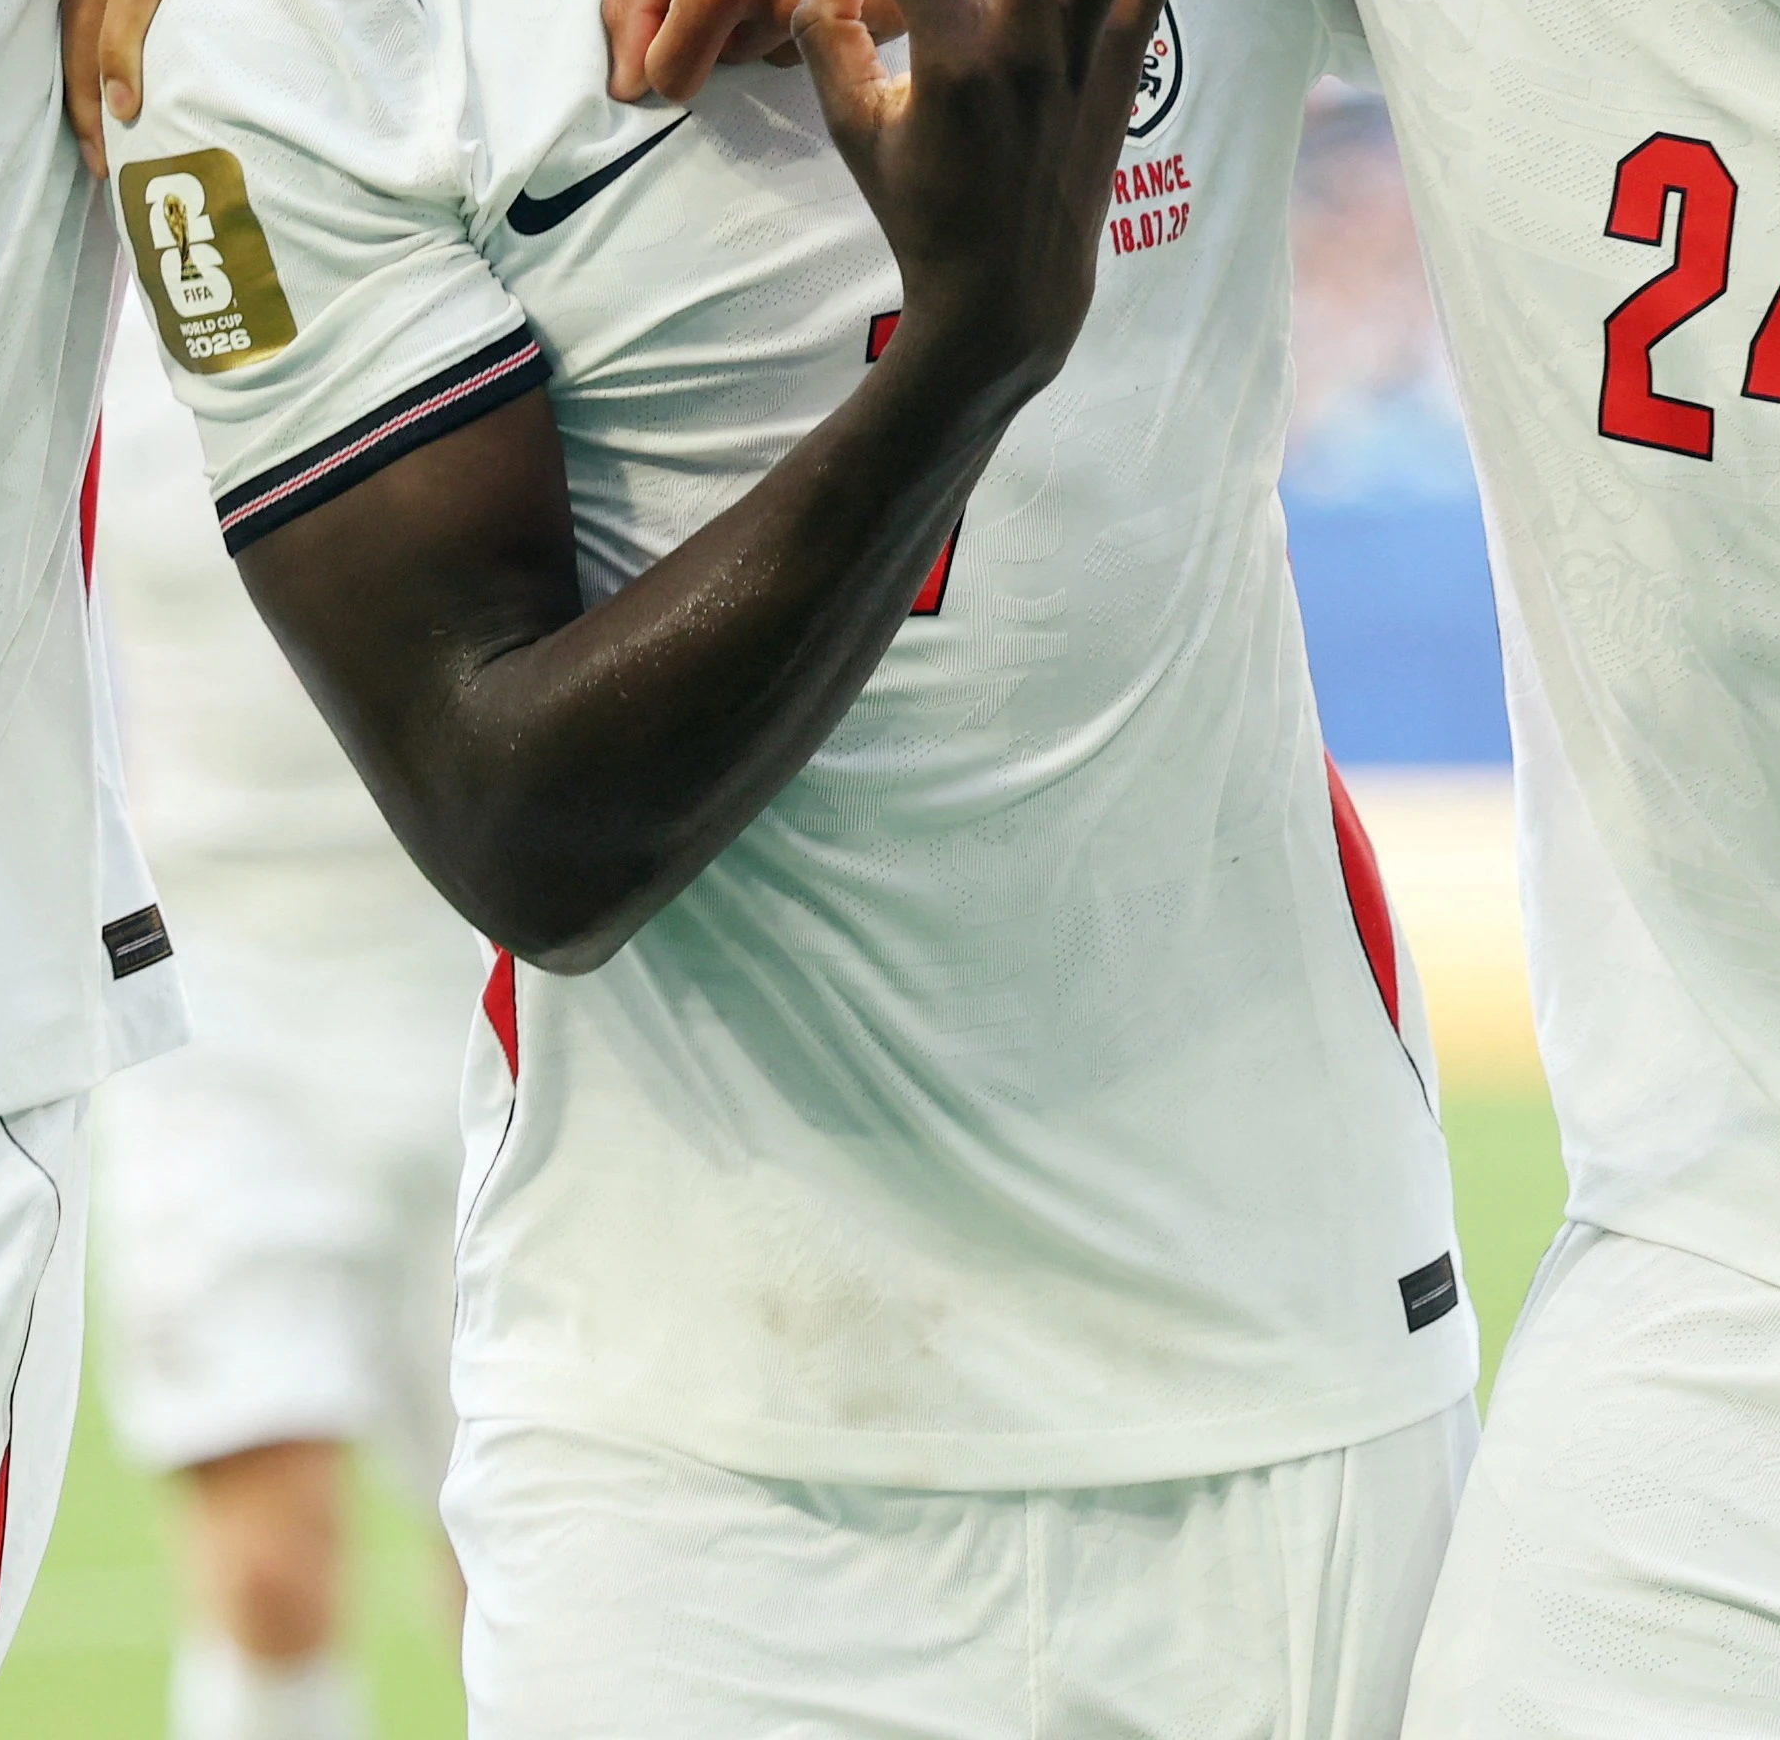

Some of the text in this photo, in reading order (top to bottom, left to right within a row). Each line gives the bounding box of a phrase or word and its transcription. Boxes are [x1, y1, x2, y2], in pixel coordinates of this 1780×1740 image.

[1113, 153, 1192, 205] RANCE
[183, 285, 214, 303] FIFA
[180, 312, 243, 337] WORLD CUP
[185, 328, 252, 359] 2026
